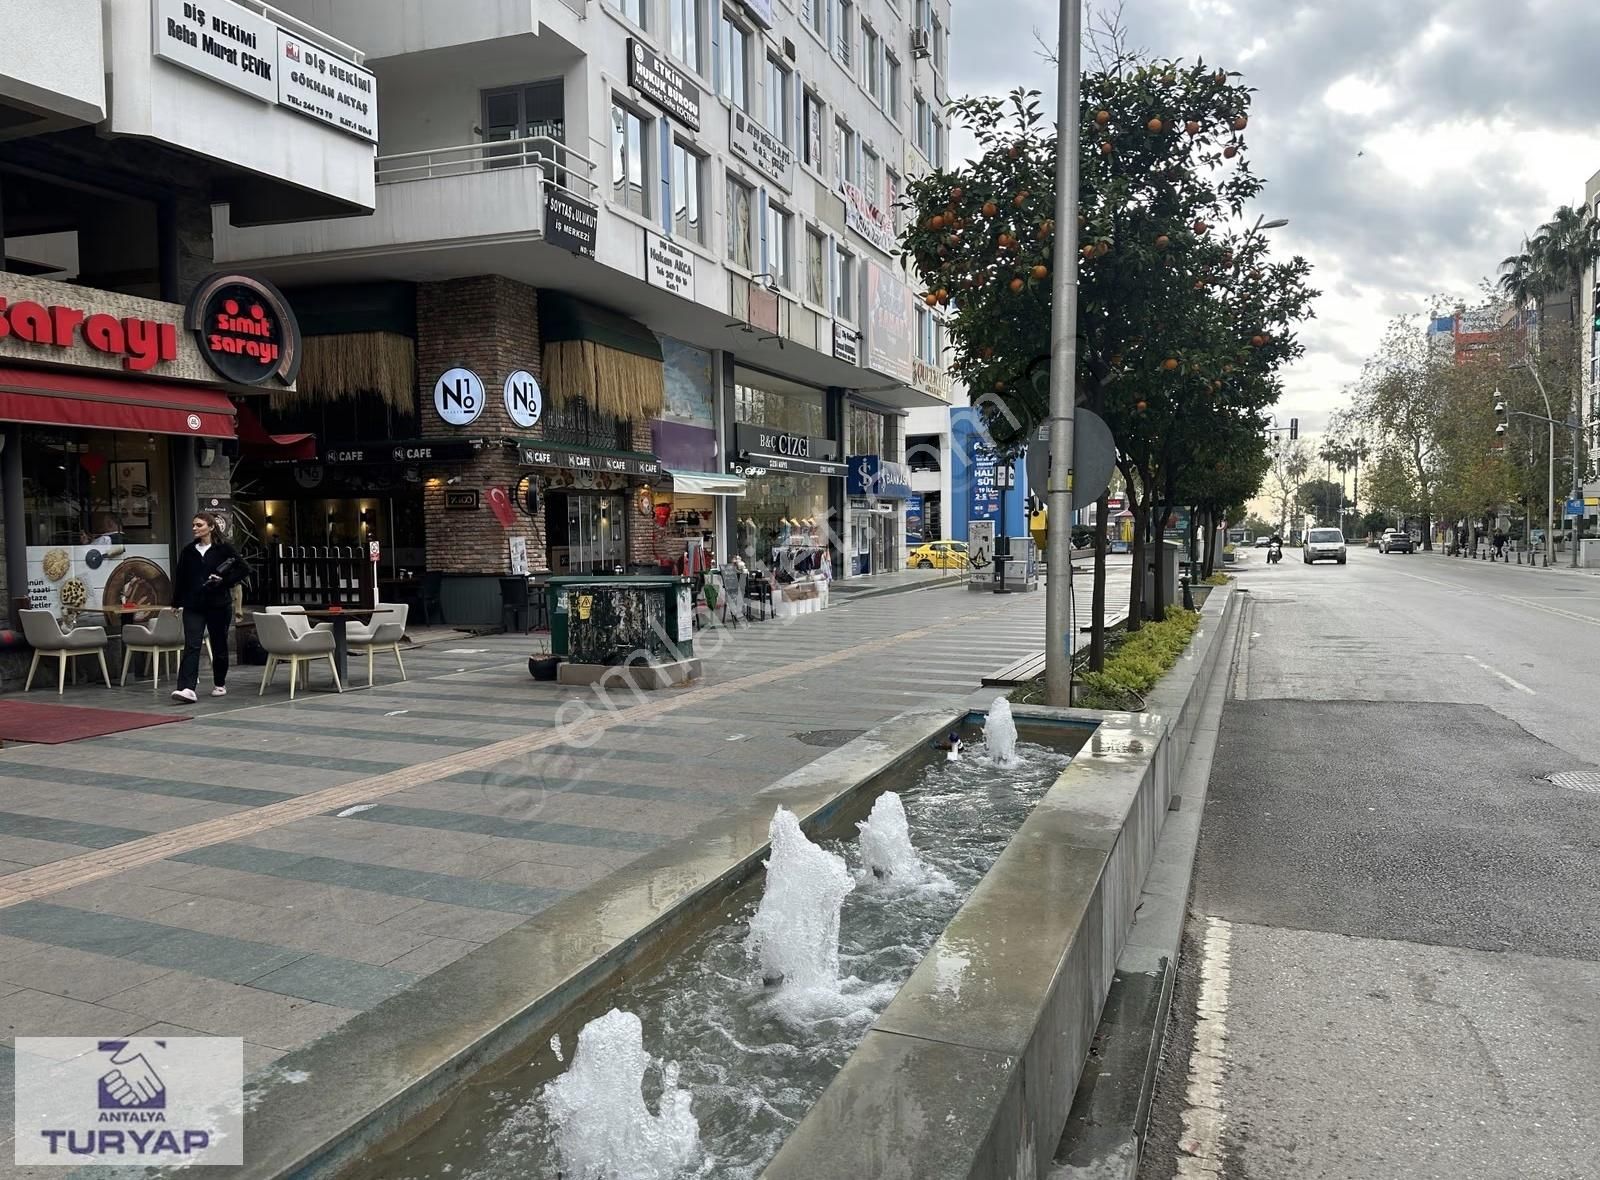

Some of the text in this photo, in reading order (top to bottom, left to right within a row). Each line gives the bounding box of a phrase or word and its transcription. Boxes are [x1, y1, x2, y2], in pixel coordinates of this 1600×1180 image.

[183, 2, 257, 50] DİŞ HEKİMİ
[167, 17, 198, 48] Reha
[202, 33, 238, 66] Murat
[241, 51, 272, 81] ÇEVİK
[305, 52, 326, 74] DİŞ
[329, 63, 371, 93] HEKİMİ
[654, 58, 683, 90] ETKİN
[291, 71, 368, 115] GÖKHAN AKTAŞ
[636, 61, 698, 116] HUKUK BÜROSU
[287, 94, 302, 106] TEL:
[550, 197, 572, 222] SOYTAŞ
[563, 223, 590, 242] MERKEZİ
[217, 299, 270, 337] simit
[339, 451, 364, 461] CAFE
[406, 448, 432, 459] CAFE
[534, 452, 551, 463] CAFE
[576, 457, 591, 467] CAFE
[612, 460, 626, 470] CAFE
[645, 464, 657, 473] CAFE
[974, 469, 994, 477] HAL
